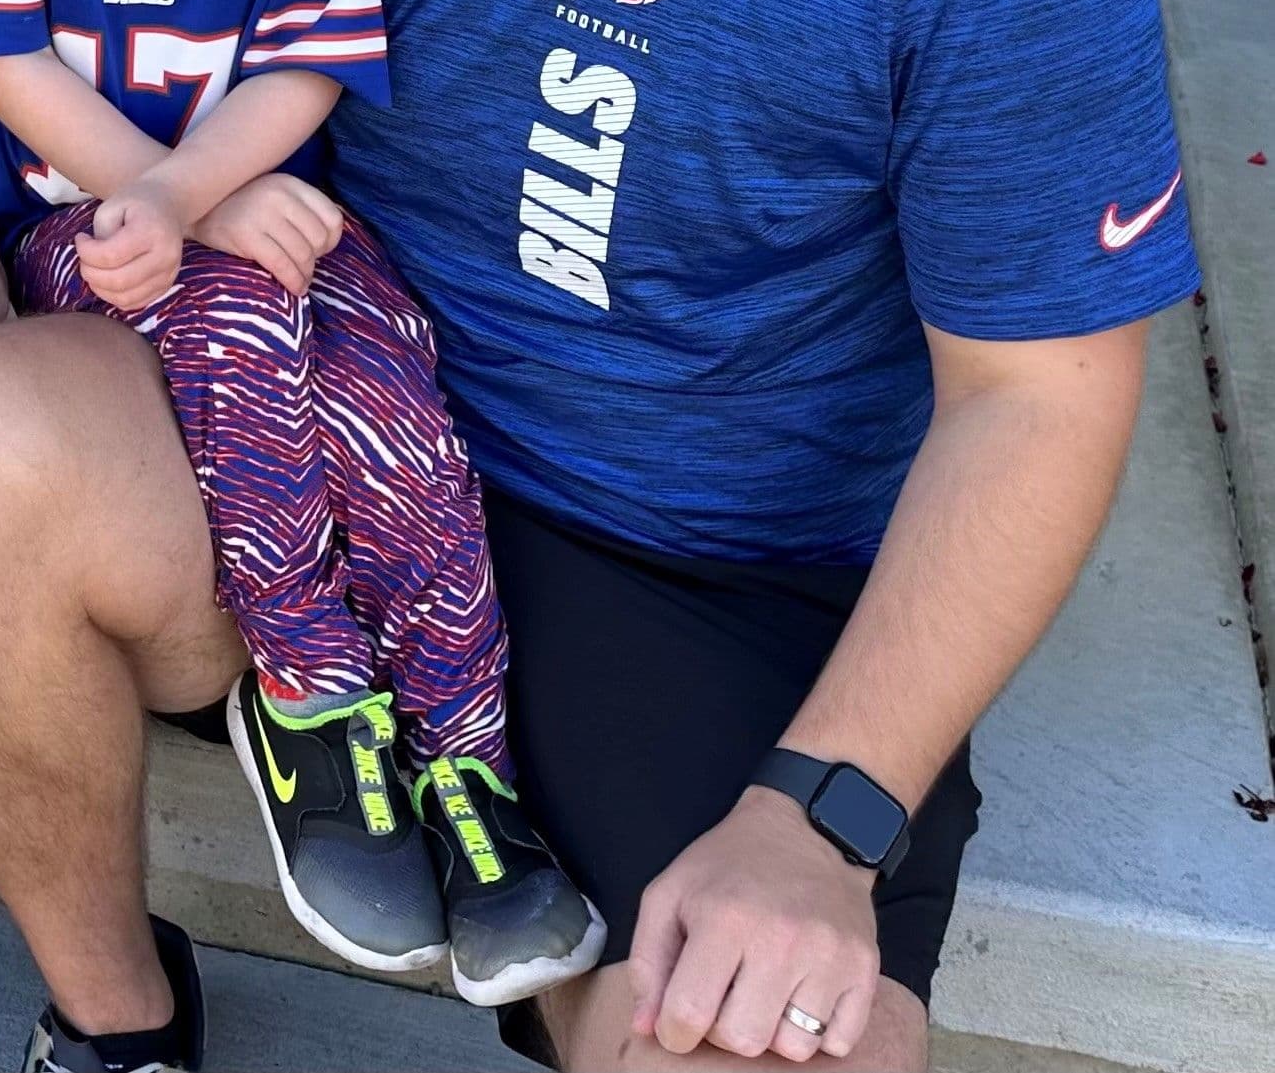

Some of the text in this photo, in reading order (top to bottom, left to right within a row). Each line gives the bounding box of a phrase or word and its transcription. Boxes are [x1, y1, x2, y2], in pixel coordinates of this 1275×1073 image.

[555, 4, 651, 54] FOOTBALL
[517, 46, 638, 312] BILLS
[361, 791, 395, 832] NIKE
